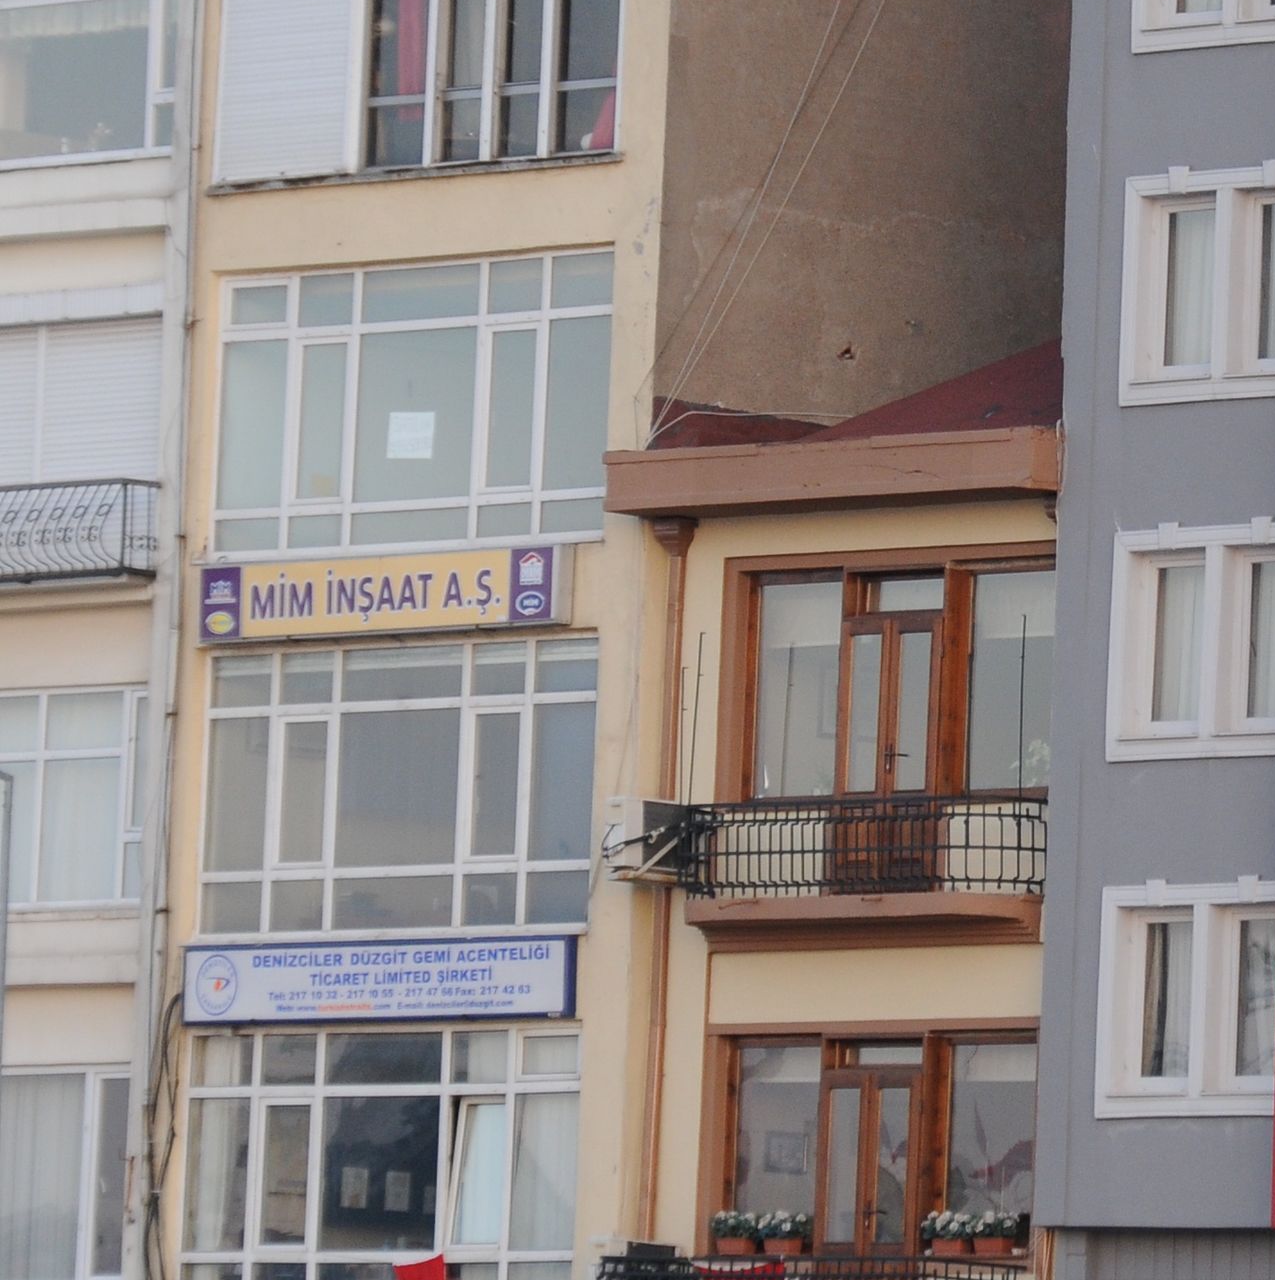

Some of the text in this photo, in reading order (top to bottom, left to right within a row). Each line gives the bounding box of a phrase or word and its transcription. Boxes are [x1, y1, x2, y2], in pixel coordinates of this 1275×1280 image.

[250, 569, 501, 623] MİM İNŞAAT A.Ş.
[252, 952, 343, 968] DENİZCİLER
[351, 949, 407, 966] DÜZGİT
[412, 947, 451, 964] GEMİ
[456, 944, 550, 963] ACENTELİĞİ
[309, 966, 492, 987] TİCARET LİMİTED ŞİRKETİ
[289, 991, 307, 1000] 217
[346, 990, 364, 999] 217
[404, 988, 422, 998] 217
[480, 986, 498, 995] 217
